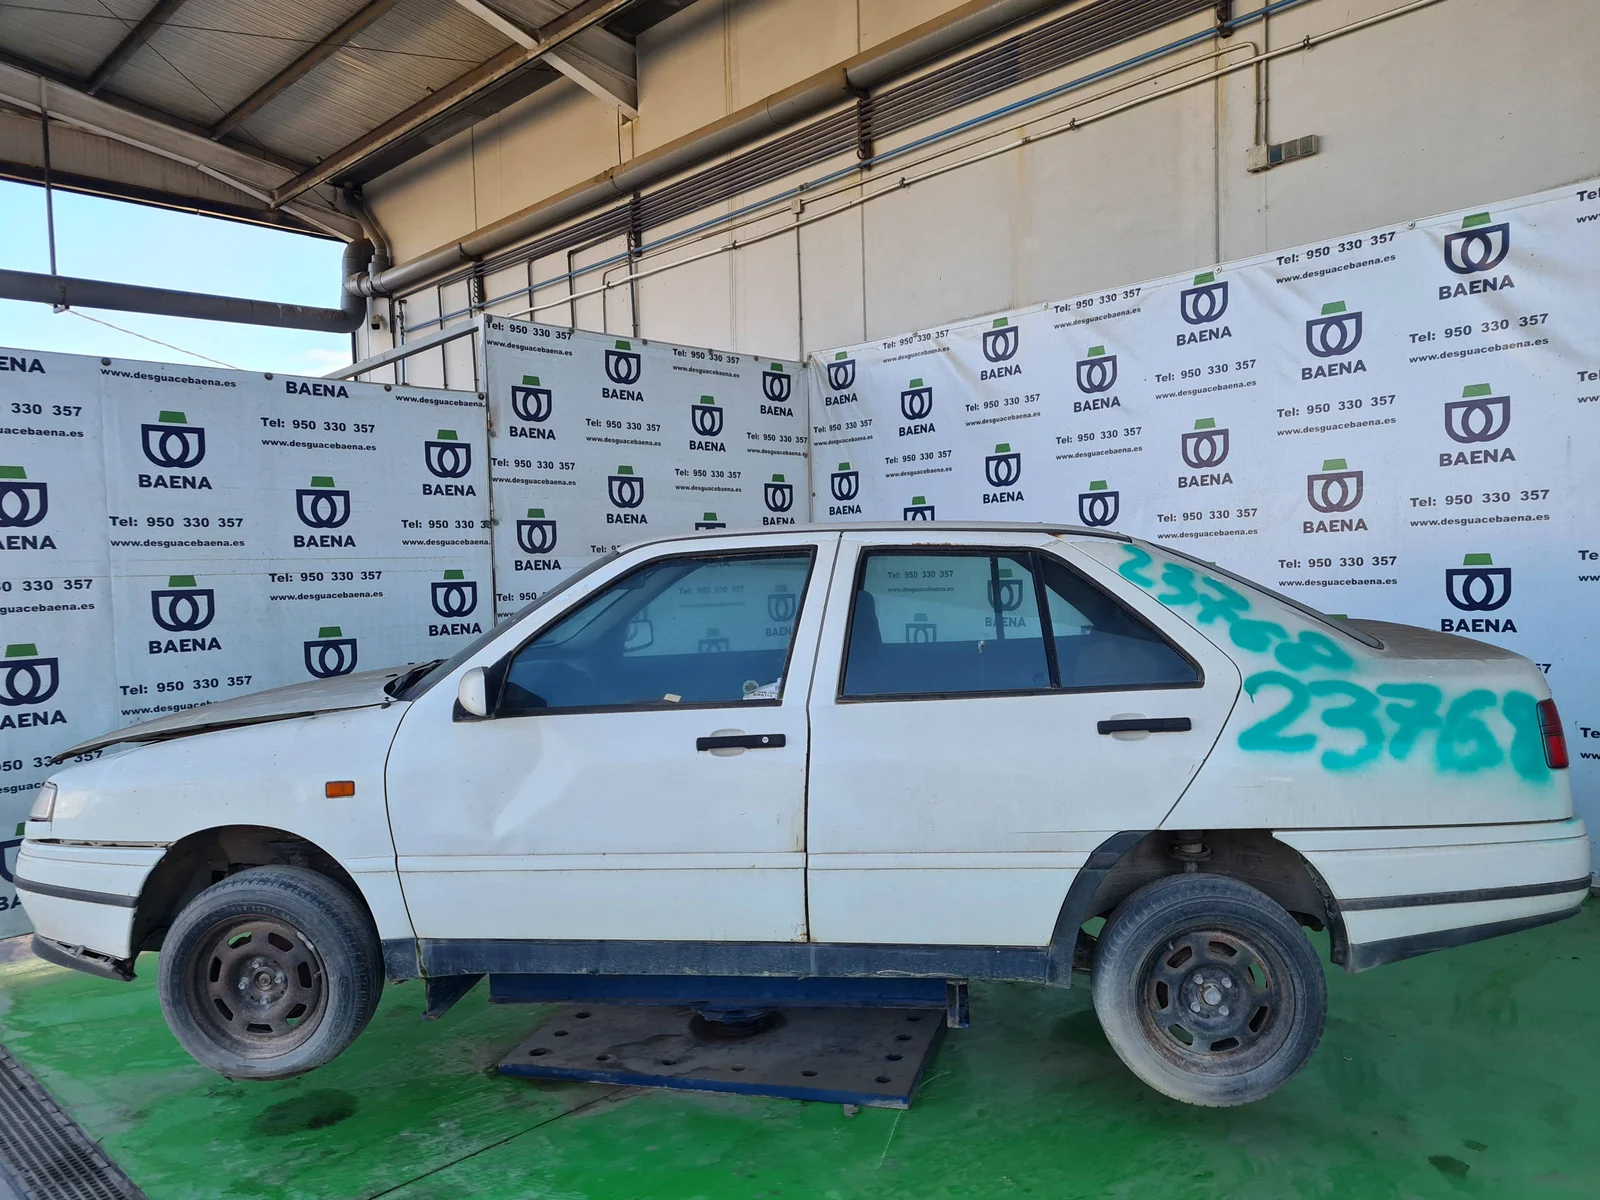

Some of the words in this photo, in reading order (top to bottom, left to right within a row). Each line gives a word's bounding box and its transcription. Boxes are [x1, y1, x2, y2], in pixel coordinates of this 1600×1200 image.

[1276, 254, 1299, 266] Tel:
[1306, 246, 1330, 259] 950
[1338, 239, 1362, 253] 330
[1370, 231, 1396, 245] 357
[1276, 255, 1396, 284] www.desguacebaena.es
[1439, 275, 1514, 300] BAENA
[1054, 303, 1070, 313] Tel:
[1076, 298, 1093, 309] 950
[1099, 293, 1117, 304] 330
[1123, 288, 1141, 299] 357
[1054, 308, 1141, 329] www.desguacebaena.es
[486, 322, 504, 331] Tel:
[509, 324, 527, 334] 950
[533, 328, 550, 338] 330
[556, 331, 572, 340] 357
[1409, 331, 1435, 343] Tel:
[1444, 325, 1472, 338] 950
[1482, 319, 1509, 333] 330
[1519, 313, 1548, 327] 357
[883, 341, 896, 349] Tel:
[900, 337, 914, 346] 950
[917, 333, 931, 342] 330
[935, 330, 950, 339] 357
[1177, 326, 1232, 346] BAENA
[486, 339, 572, 356] www.desguacebaena.es
[1409, 338, 1549, 363] www.desguacebaena.es
[672, 348, 687, 357] Tel:
[691, 351, 705, 359] 950
[708, 353, 722, 362] 330
[727, 356, 740, 364] 357
[883, 347, 950, 363] www.desguacebaena.es
[673, 366, 740, 378] www.desguacebaena.es
[981, 364, 1022, 381] BAENA
[1155, 373, 1174, 383] Tel:
[1181, 368, 1201, 379] 950
[1208, 364, 1228, 375] 330
[1236, 359, 1256, 370] 357
[1302, 359, 1367, 380] BAENA
[100, 368, 236, 387] www.desguacebaena.es
[286, 381, 349, 398] BAENA
[602, 387, 644, 402] BAENA
[1155, 381, 1256, 399] www.desguacebaena.es
[825, 393, 858, 406] BAENA
[965, 403, 979, 412] Tel:
[984, 400, 999, 409] 950
[1004, 397, 1020, 406] 330
[1024, 393, 1040, 403] 357
[1074, 396, 1120, 413] BAENA
[1276, 407, 1299, 418] Tel:
[1307, 403, 1330, 414] 950
[1338, 399, 1362, 410] 330
[1371, 395, 1396, 407] 357
[11, 403, 42, 414] 330
[52, 405, 82, 416] 357
[760, 405, 793, 417] BAENA
[260, 417, 285, 428] Tel:
[292, 420, 316, 430] 950
[324, 422, 346, 432] 330
[353, 423, 375, 433] 357
[586, 418, 601, 427] Tel:
[606, 420, 622, 429] 950
[626, 422, 642, 430] 330
[646, 423, 660, 432] 357
[829, 424, 842, 432] 950
[846, 421, 857, 430] 330
[860, 419, 872, 427] 357
[966, 412, 1040, 426] www.desguacebaena.es
[509, 426, 556, 440] BAENA
[899, 423, 935, 437] BAENA
[1277, 418, 1396, 436] www.desguacebaena.es
[586, 437, 661, 446] www.desguacebaena.es
[746, 432, 759, 440] Tel:
[763, 433, 776, 441] 950
[780, 435, 792, 443] 330
[1056, 436, 1072, 444] Tel:
[1078, 433, 1095, 442] 950
[1100, 430, 1118, 439] 330
[1124, 427, 1142, 437] 357
[261, 440, 376, 451] www.desguacebaena.es
[690, 440, 726, 452] BAENA
[902, 454, 916, 462] 950
[920, 452, 934, 460] 330
[938, 450, 952, 458] 357
[1056, 446, 1142, 460] www.desguacebaena.es
[1440, 448, 1516, 467] BAENA
[492, 458, 509, 467] Tel:
[514, 459, 532, 468] 950
[537, 461, 554, 469] 330
[559, 462, 575, 470] 357
[675, 468, 689, 476] Tel:
[693, 469, 706, 477] 950
[711, 470, 724, 478] 330
[727, 471, 741, 479] 357
[886, 467, 952, 478] www.desguacebaena.es
[138, 474, 212, 490] BAENA
[492, 476, 576, 486] www.desguacebaena.es
[1178, 473, 1233, 488] BAENA
[422, 484, 476, 496] BAENA
[983, 491, 1024, 504] BAENA
[1410, 497, 1436, 507] Tel:
[1445, 494, 1472, 505] 950
[1482, 492, 1510, 503] 330
[1520, 489, 1550, 501] 357
[829, 504, 862, 515] BAENA
[1157, 514, 1176, 522] Tel:
[1182, 512, 1202, 521] 950
[1209, 510, 1229, 519] 330
[1237, 508, 1257, 518] 357
[109, 516, 138, 526] Tel:
[147, 517, 174, 527] 950
[183, 518, 209, 527] 330
[218, 518, 243, 527] 357
[401, 520, 422, 528] Tel:
[428, 520, 448, 528] 950
[455, 520, 474, 528] 330
[606, 514, 648, 524] BAENA
[763, 517, 795, 525] BAENA
[1303, 518, 1368, 534] BAENA
[1410, 514, 1550, 526] www.desguacebaena.es
[294, 535, 356, 547] BAENA
[1158, 530, 1258, 539] www.desguacebaena.es
[110, 539, 245, 548] www.desguacebaena.es
[515, 560, 561, 571] BAENA
[1278, 559, 1300, 568] Tel:
[1308, 558, 1332, 568] 950
[1340, 557, 1364, 567] 330
[1372, 556, 1397, 566] 357
[268, 573, 293, 582] Tel:
[300, 572, 324, 582] 950
[331, 572, 353, 581] 330
[361, 571, 382, 580] 357
[1279, 578, 1398, 587] www.desguacebaena.es
[22, 580, 53, 591] 330
[64, 579, 93, 590] 357
[270, 592, 383, 601] www.desguacebaena.es
[496, 594, 514, 602] Tel:
[519, 592, 536, 600] 950
[429, 623, 482, 636] BAENA
[1441, 619, 1517, 633] BAENA
[149, 637, 222, 654] BAENA
[120, 684, 148, 695] Tel:
[157, 681, 184, 692] 950
[193, 678, 219, 689] 330
[227, 676, 252, 686] 357
